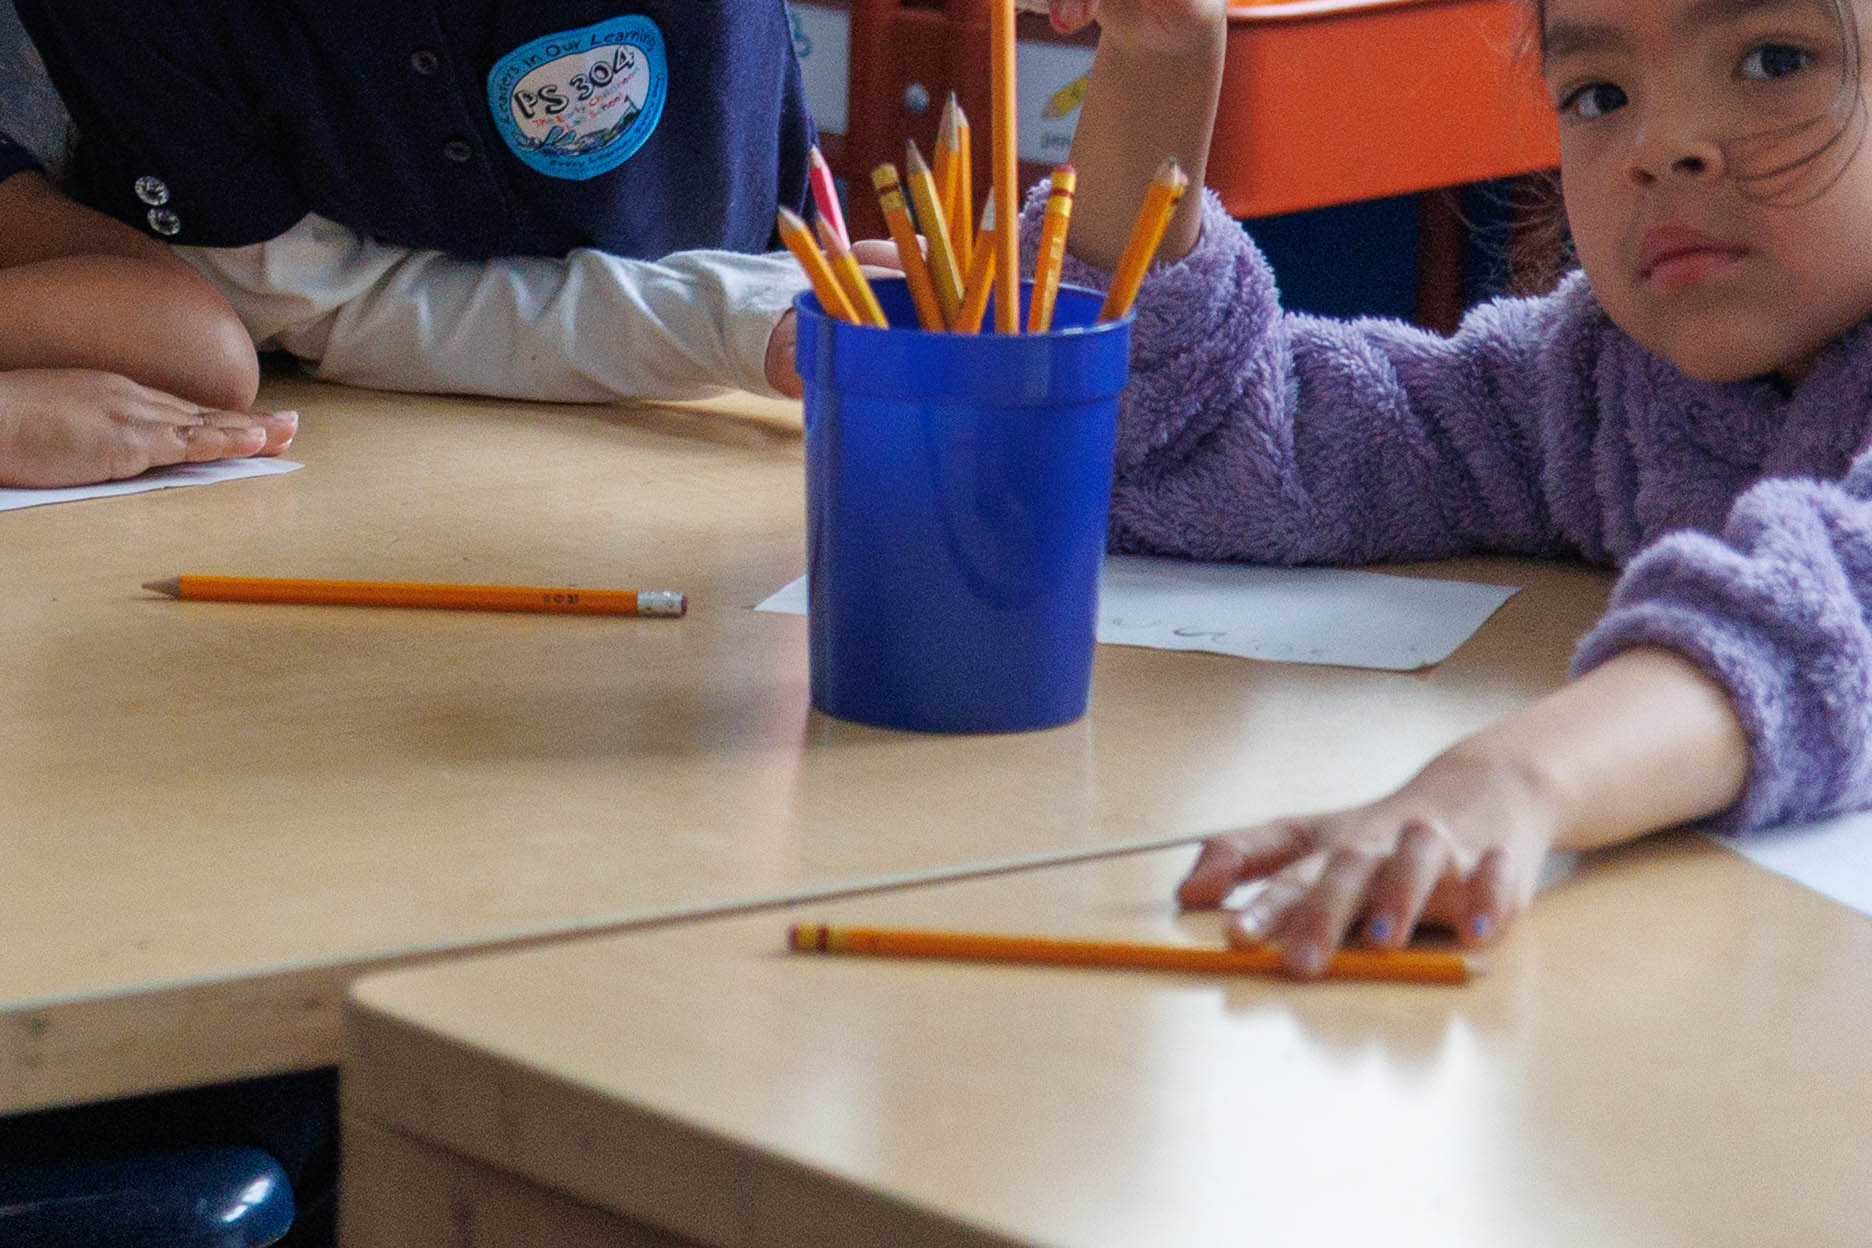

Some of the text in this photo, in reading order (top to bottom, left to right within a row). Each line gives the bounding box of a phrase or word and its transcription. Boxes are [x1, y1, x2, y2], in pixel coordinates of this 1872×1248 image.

[545, 39, 583, 57] Our
[589, 30, 657, 52] Learning
[570, 44, 636, 102] 304
